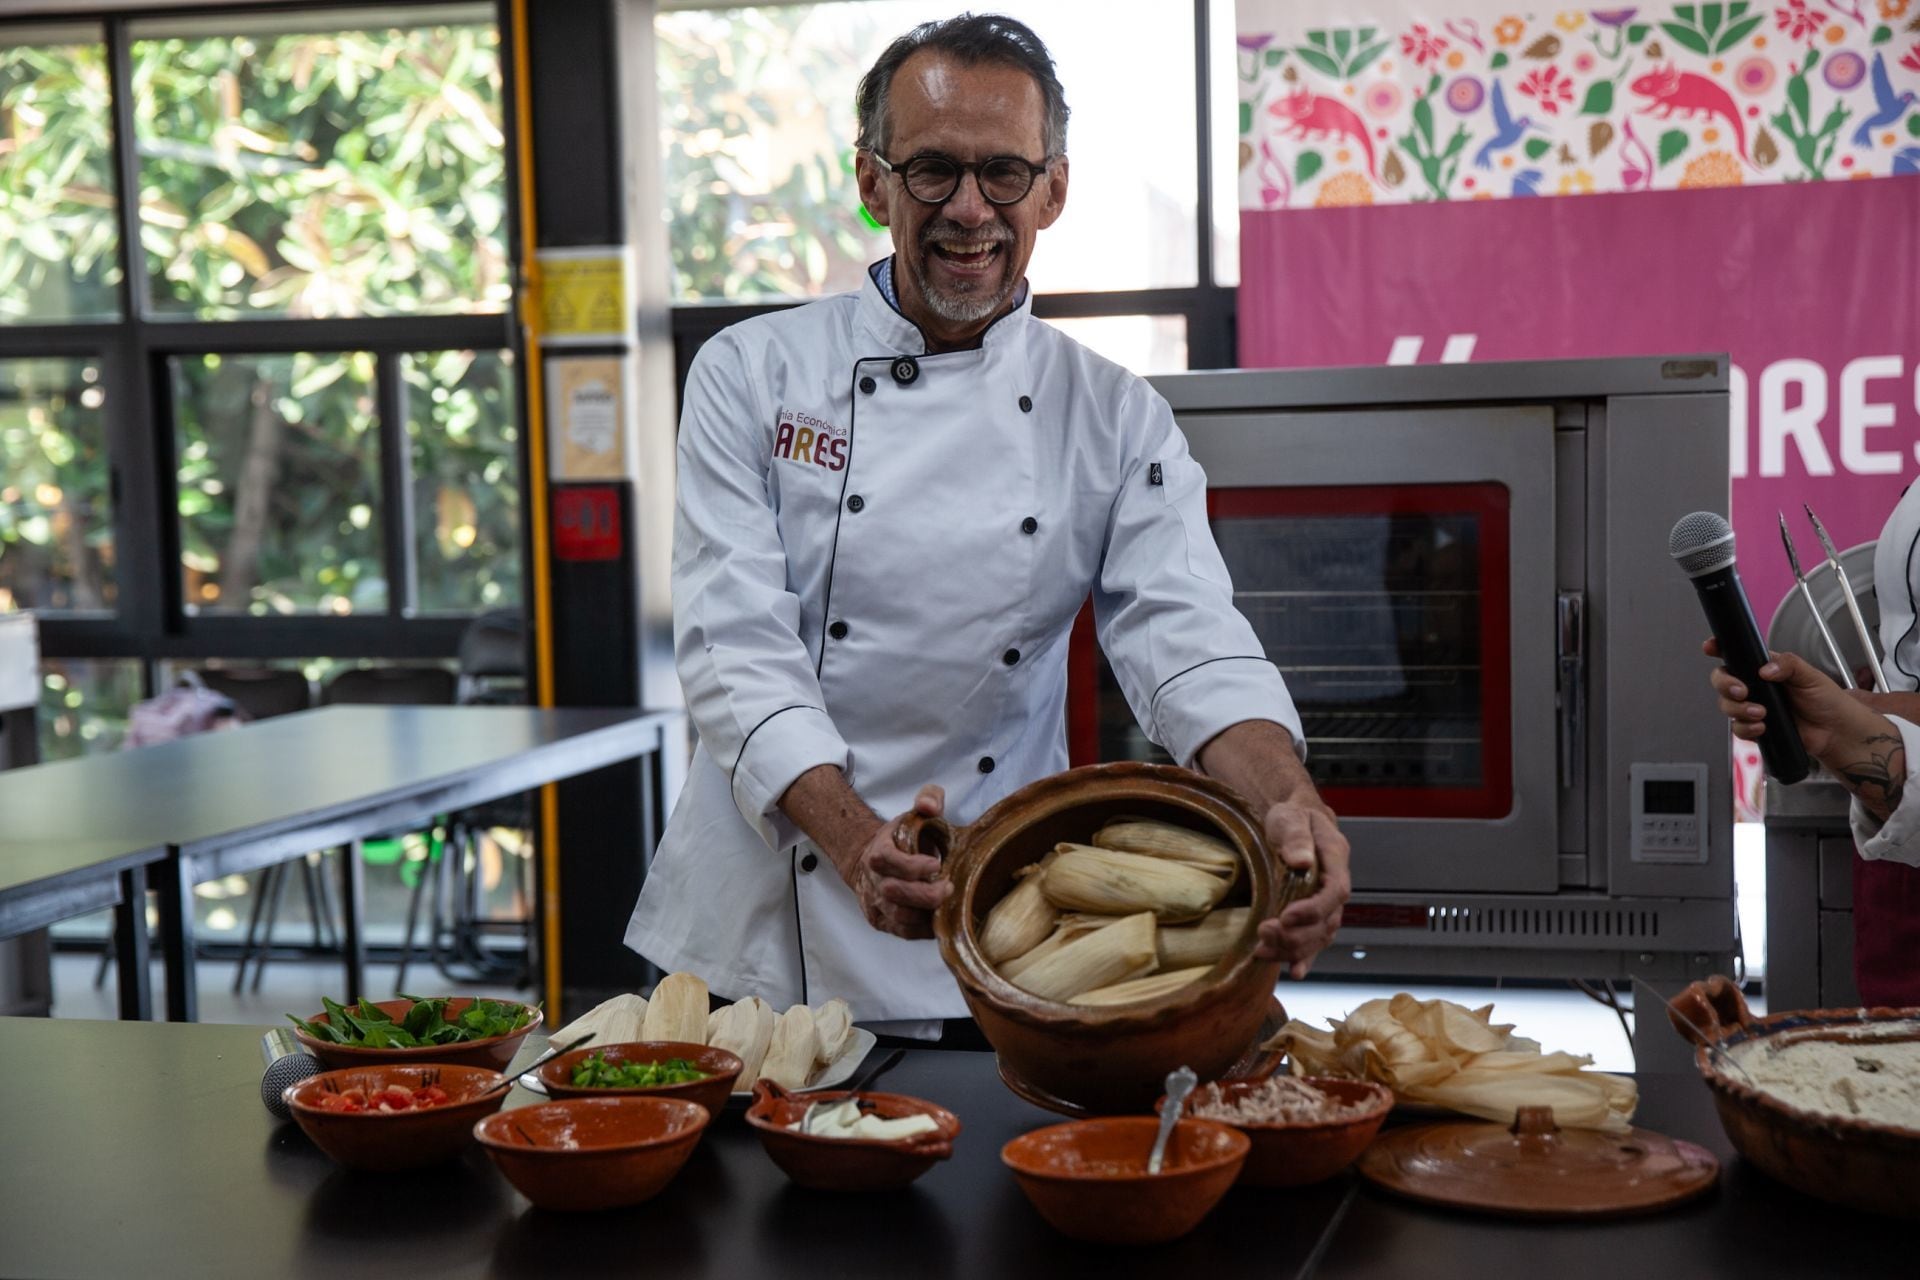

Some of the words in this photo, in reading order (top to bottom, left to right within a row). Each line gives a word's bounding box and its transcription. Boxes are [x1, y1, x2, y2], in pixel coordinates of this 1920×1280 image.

[797, 413, 847, 436] Económica
[1730, 354, 1920, 478] RE
[774, 423, 847, 471] ARES
